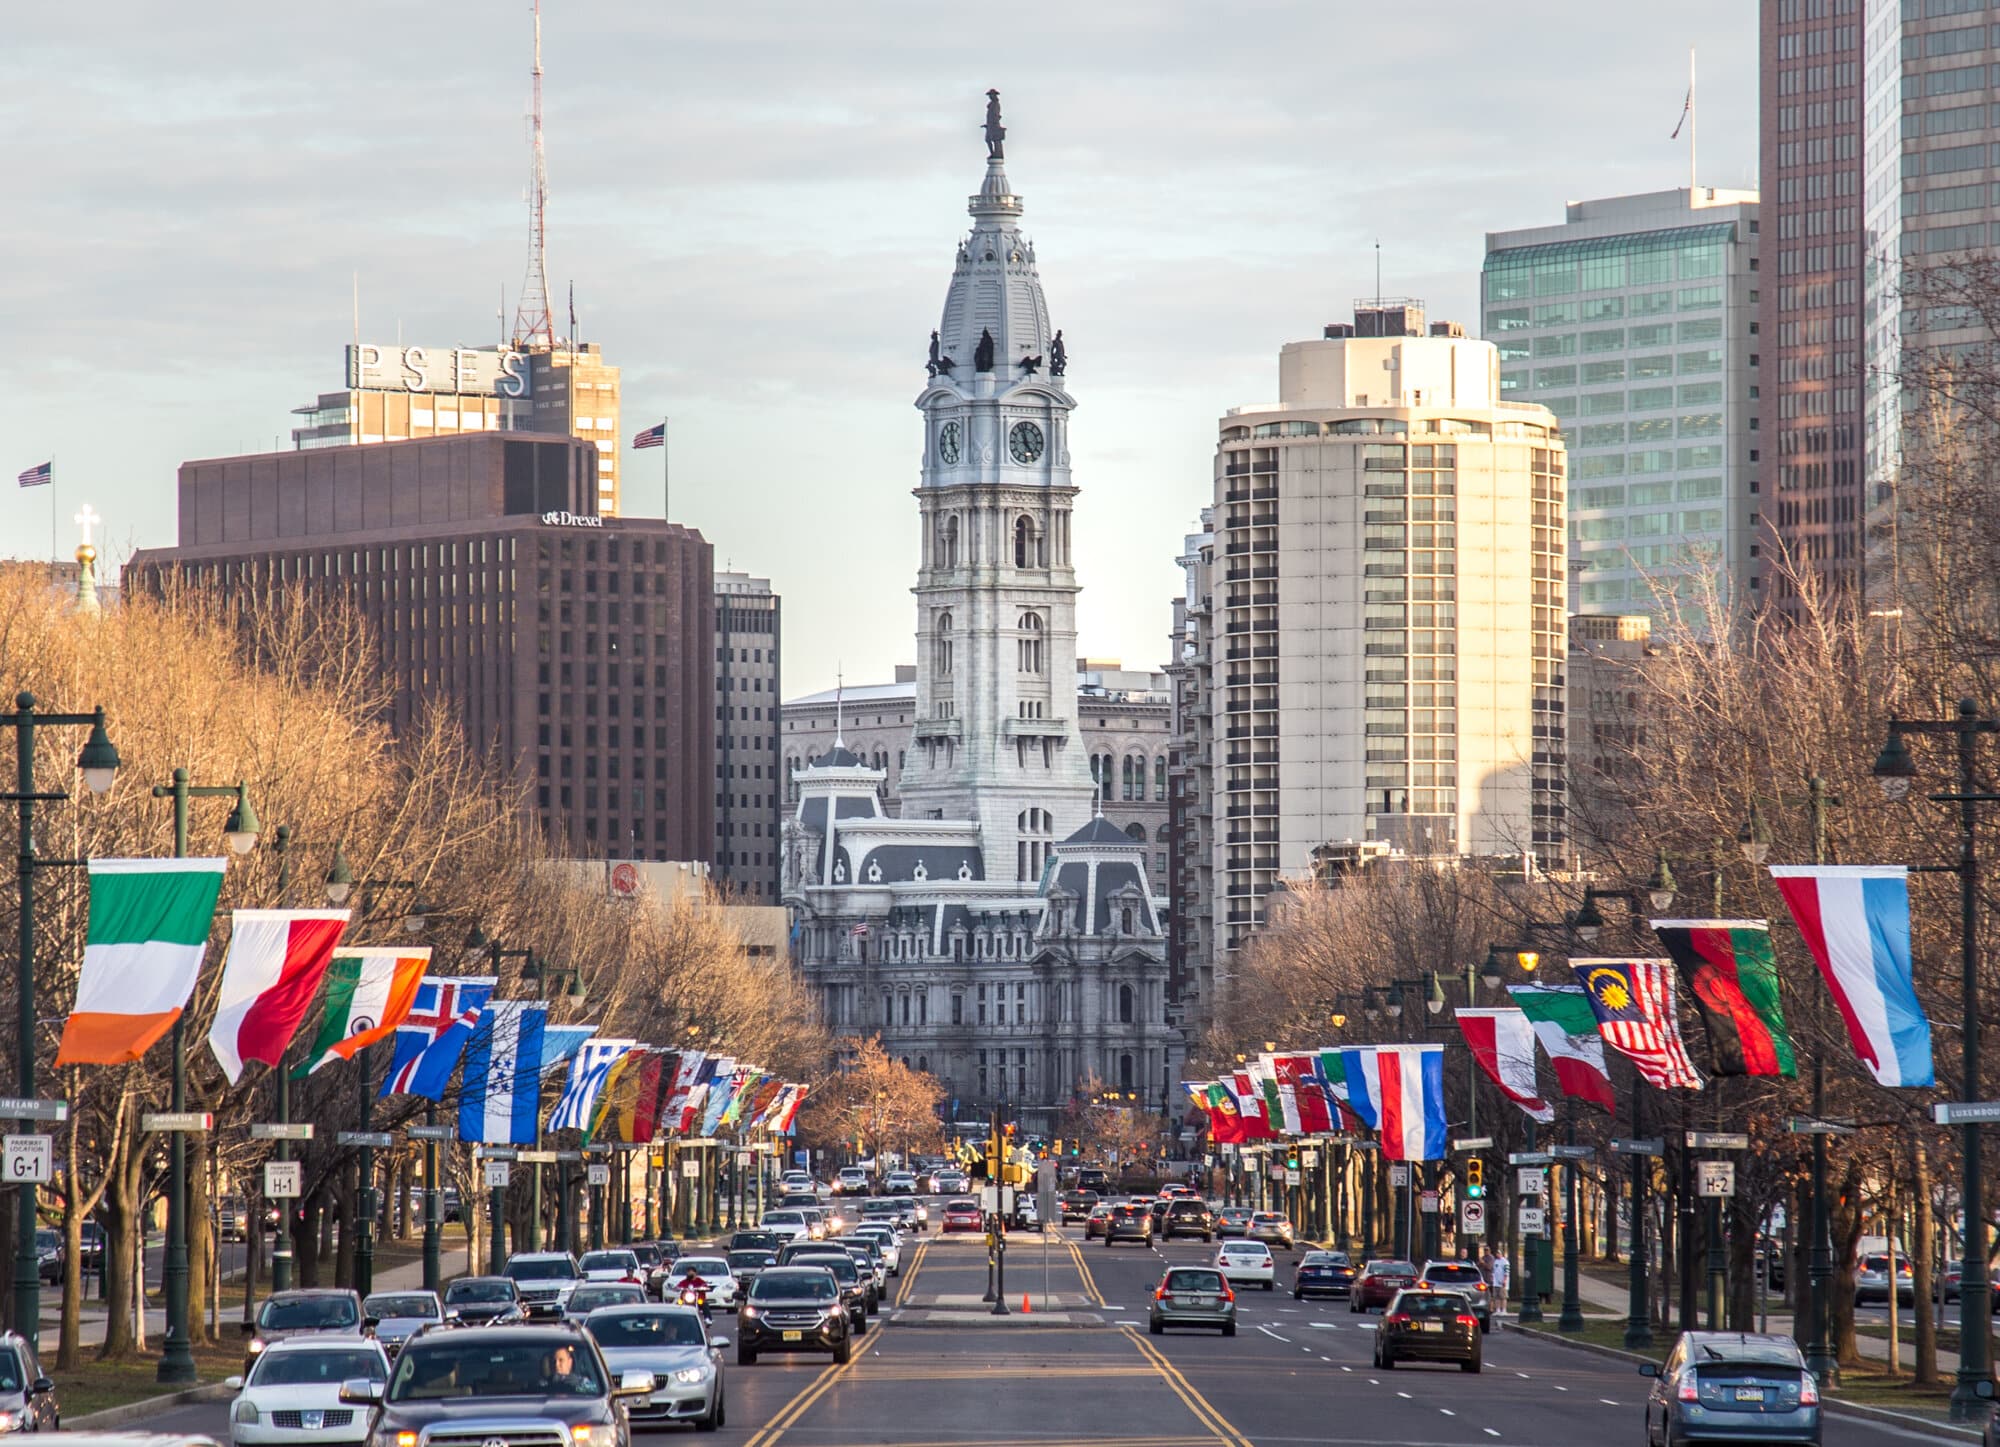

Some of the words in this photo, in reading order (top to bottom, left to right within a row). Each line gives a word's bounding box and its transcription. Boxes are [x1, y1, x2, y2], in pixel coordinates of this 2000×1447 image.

[357, 344, 525, 397] PSFS
[560, 511, 602, 527] Drexel
[1, 1101, 40, 1110] IRELAND
[14, 1156, 38, 1177] G-1
[273, 1177, 292, 1193] H-1
[1526, 1179, 1538, 1191] I-2
[1706, 1177, 1728, 1193] H-2
[1525, 1212, 1537, 1220] NO
[1521, 1222, 1542, 1231] TURNS
